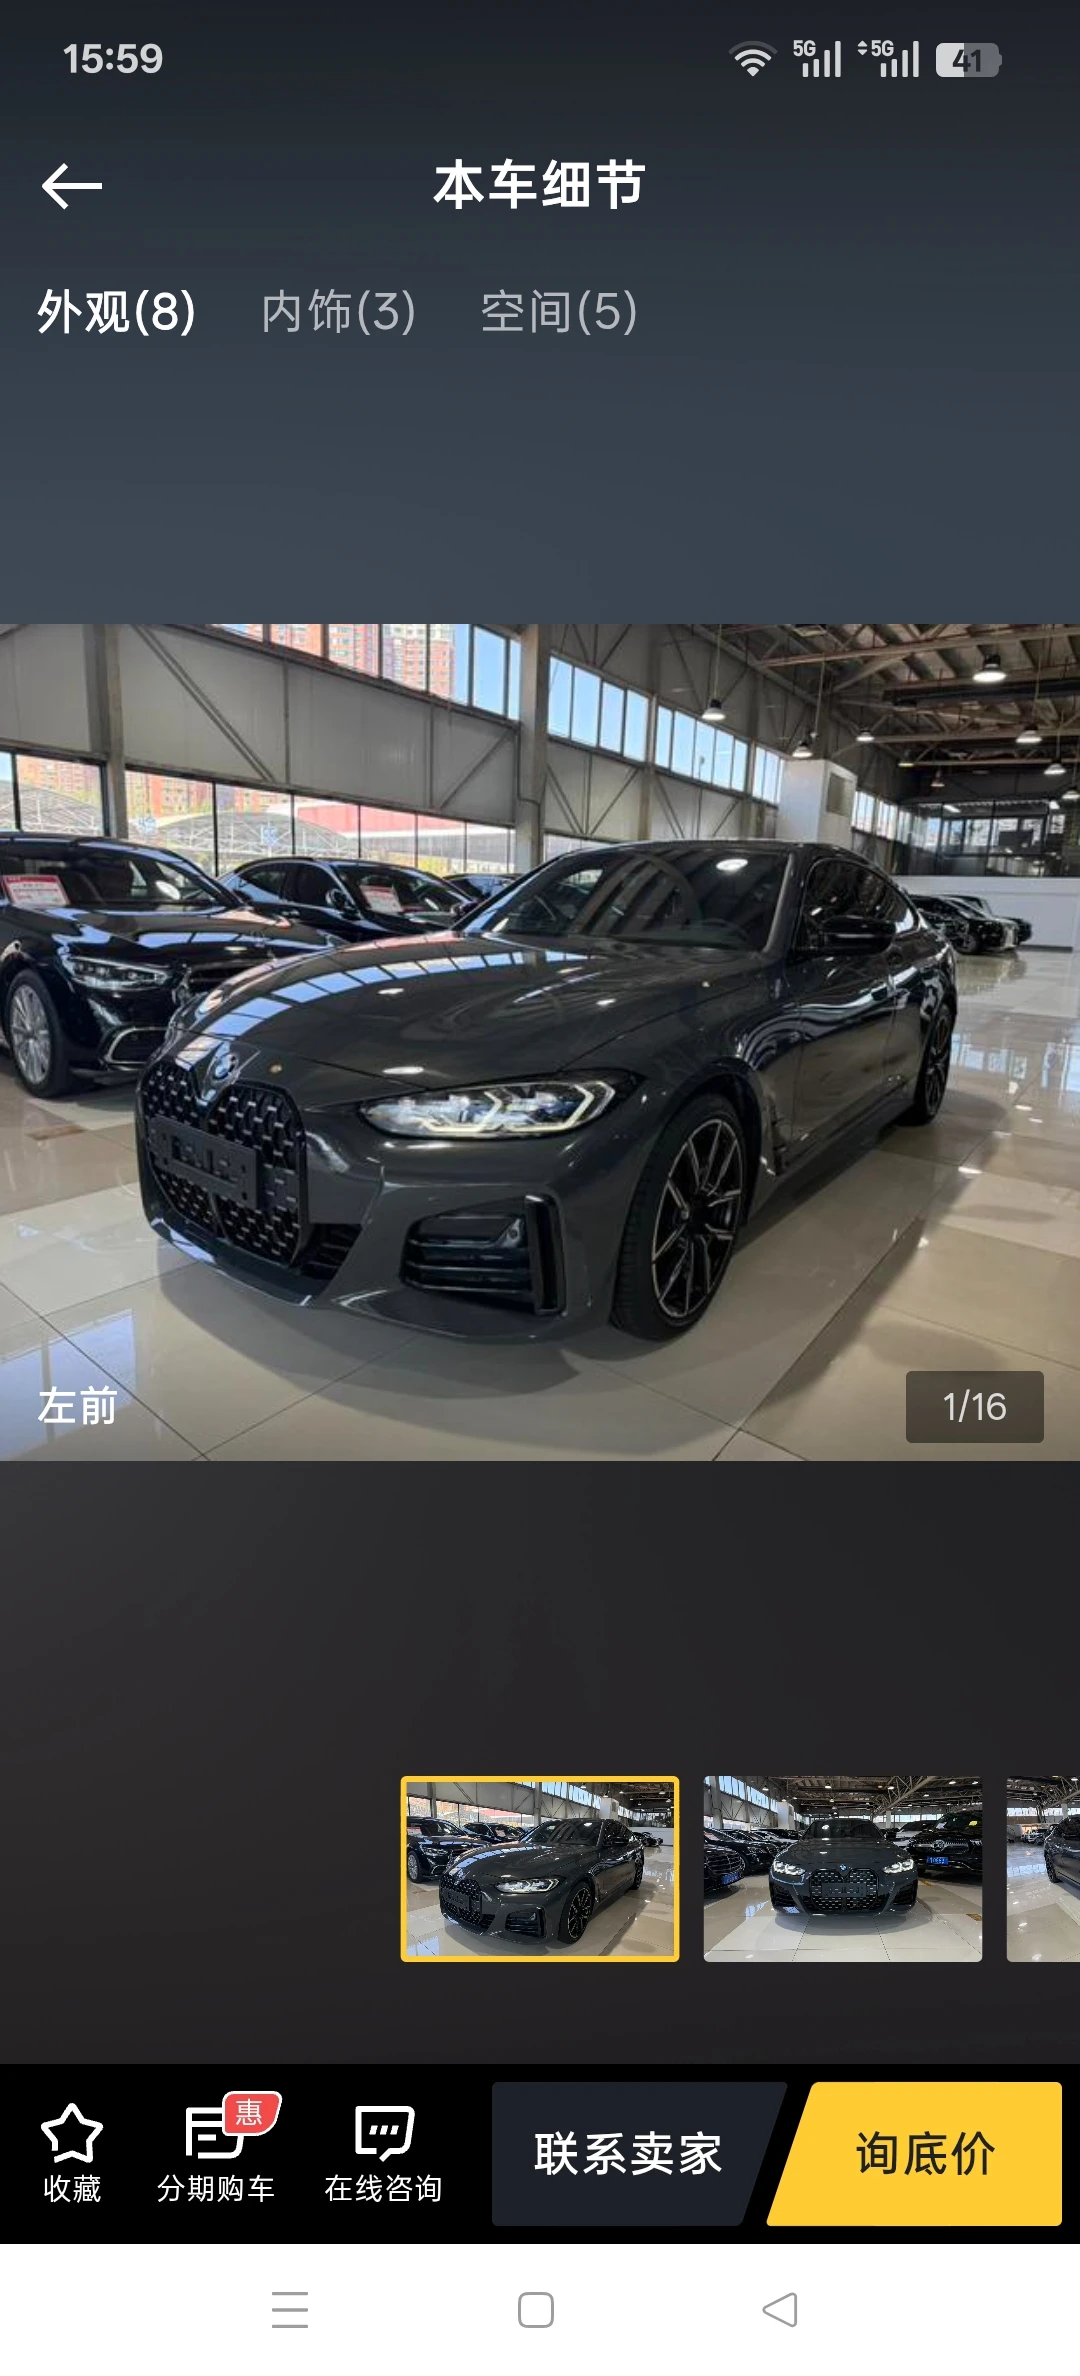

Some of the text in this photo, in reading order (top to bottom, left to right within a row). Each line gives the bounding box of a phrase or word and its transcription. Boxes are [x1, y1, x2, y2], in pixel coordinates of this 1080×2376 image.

[63, 43, 163, 74] 15:59
[793, 39, 817, 57] 5G
[871, 39, 895, 57] 5G
[952, 49, 981, 73] 41
[433, 158, 646, 209] 本车细节
[37, 289, 195, 336] 外观(8)
[263, 289, 415, 336] 内饰(3)
[481, 289, 637, 336] 空间(5)
[236, 2098, 262, 2125] 惠
[533, 2130, 723, 2176] 联系卖家
[856, 2130, 996, 2176] 询底价
[43, 2173, 102, 2203] 收藏
[157, 2173, 275, 2203] 分期购车
[325, 2173, 442, 2203] 在线咨询
